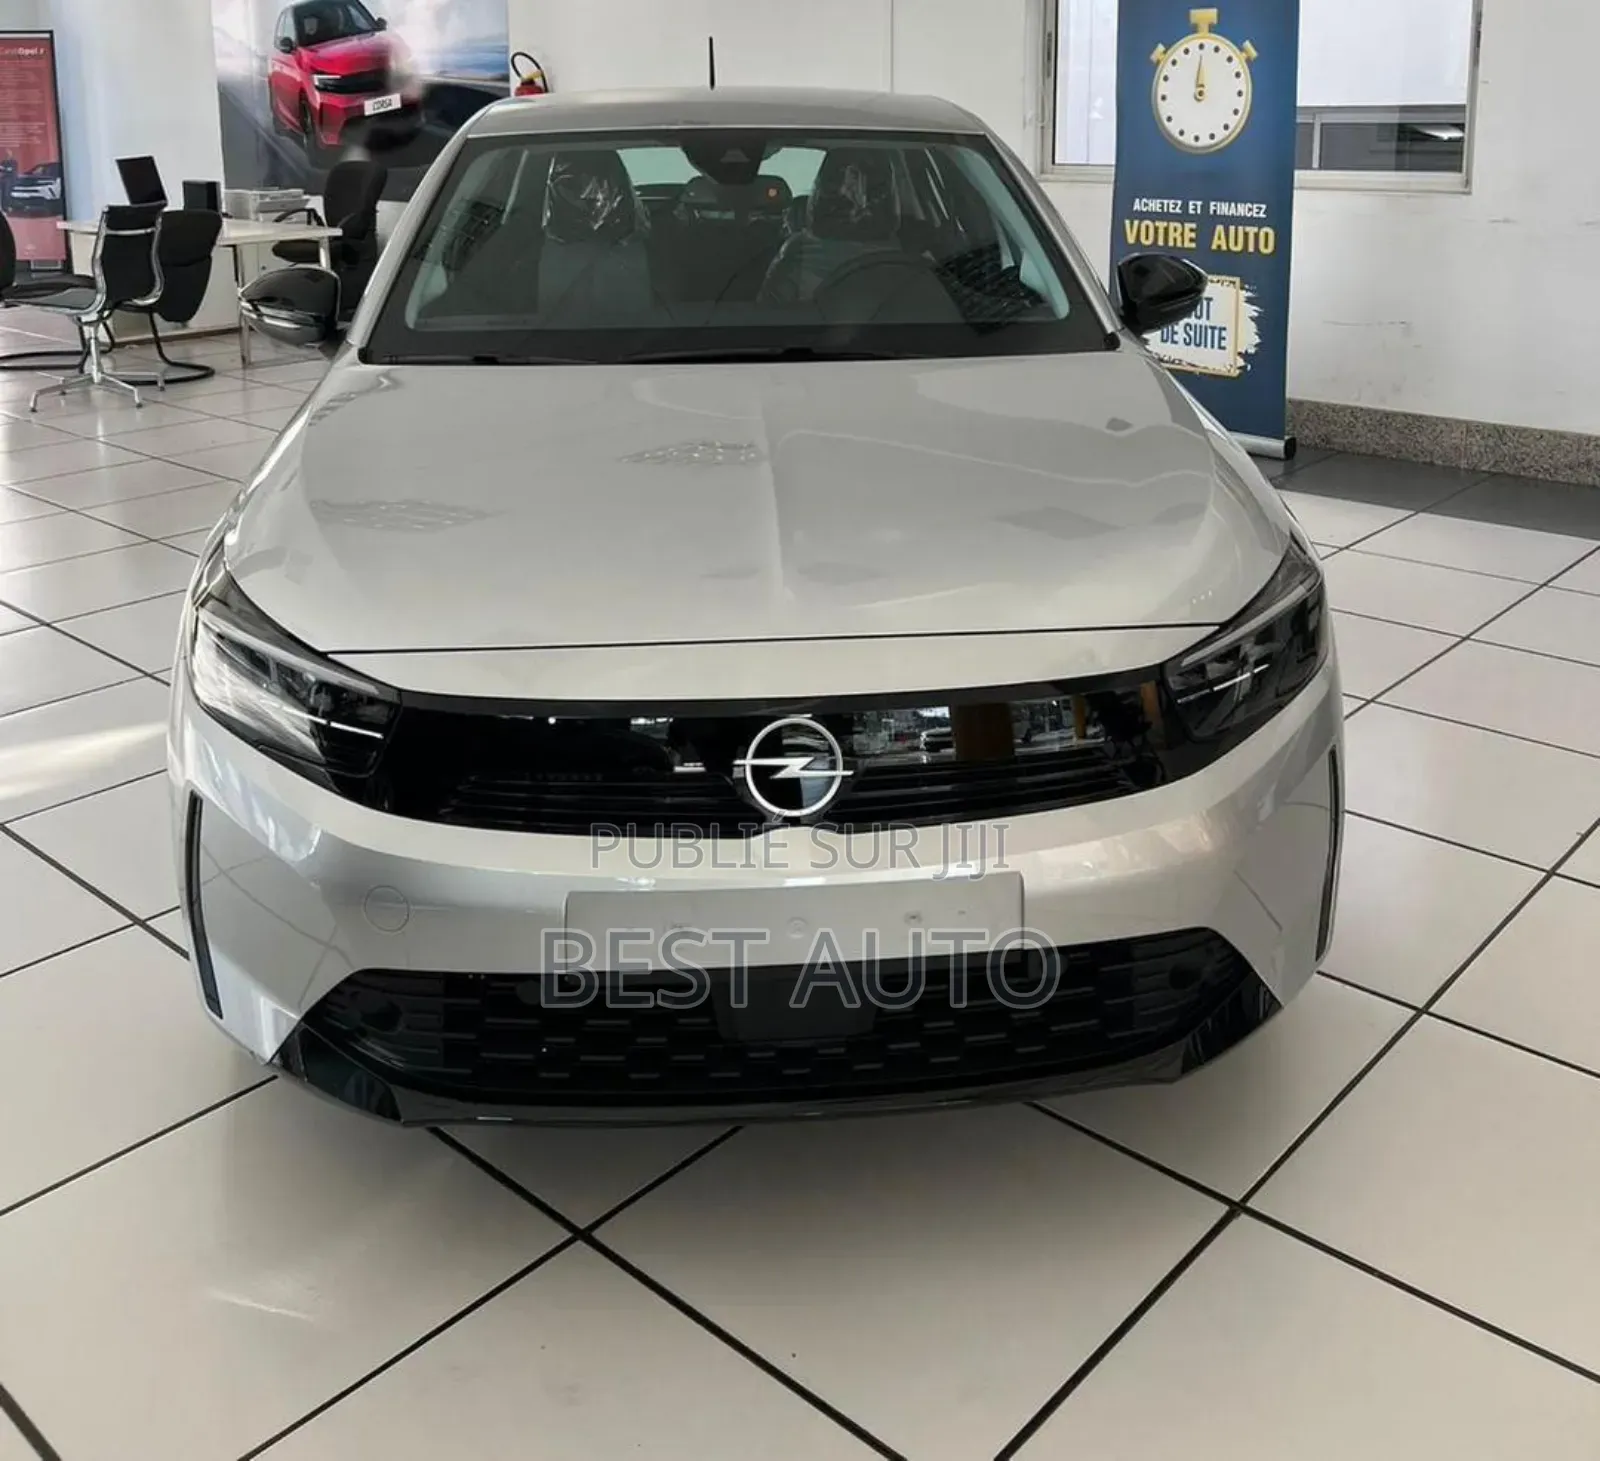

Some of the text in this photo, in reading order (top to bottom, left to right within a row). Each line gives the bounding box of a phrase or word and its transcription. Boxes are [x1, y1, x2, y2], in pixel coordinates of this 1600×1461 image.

[1133, 198, 1268, 218] ACHETEZ ET FINANCEZ
[1124, 219, 1275, 254] VOTRE AUTO
[1193, 297, 1214, 321] UT
[1160, 322, 1227, 350] DE SUITE
